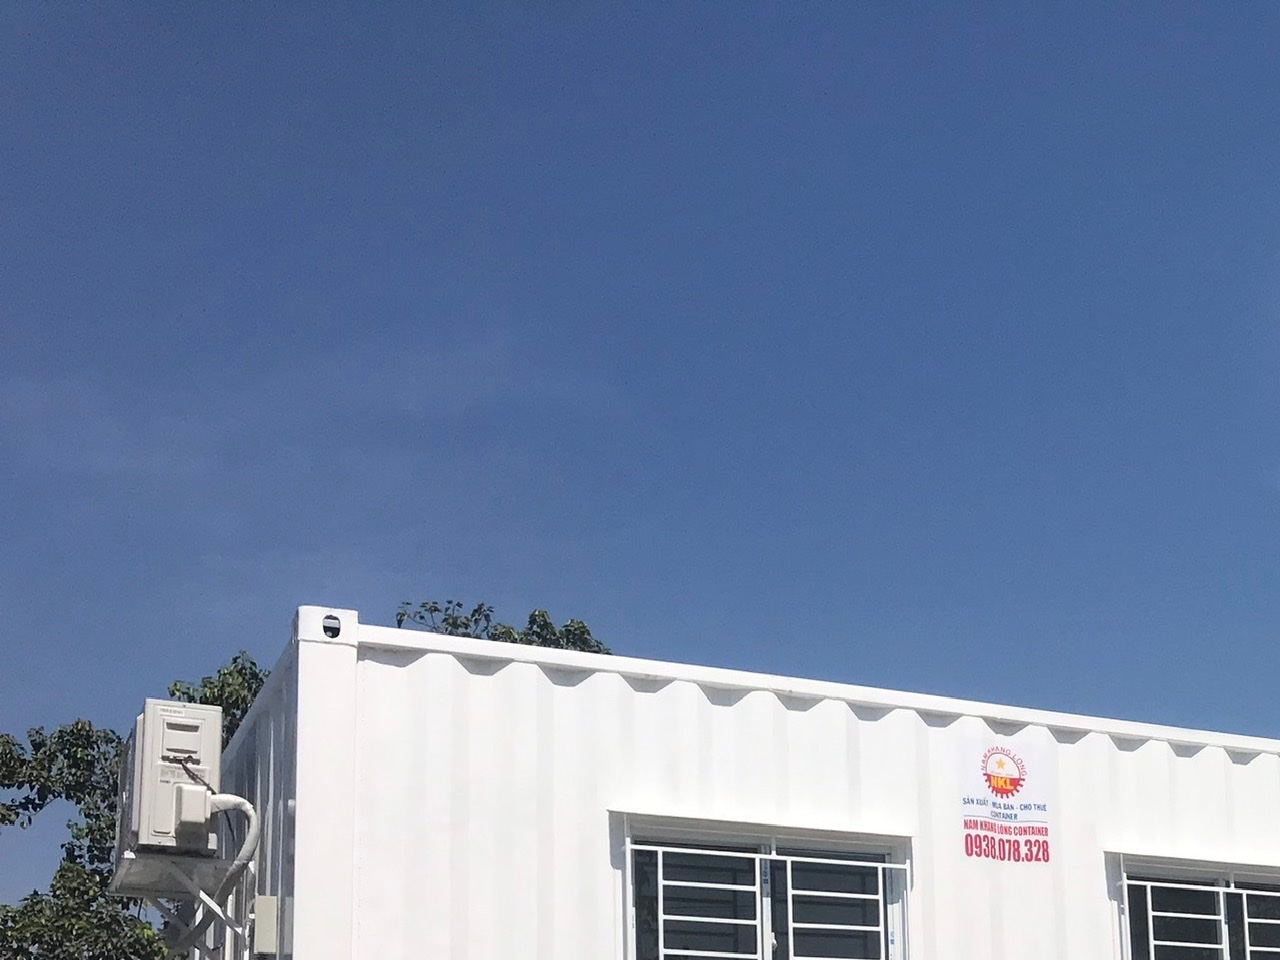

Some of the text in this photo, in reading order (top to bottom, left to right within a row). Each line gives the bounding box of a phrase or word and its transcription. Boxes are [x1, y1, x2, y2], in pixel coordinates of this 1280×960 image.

[991, 775, 1015, 790] NKL
[1019, 803, 1033, 811] CHO
[990, 810, 1018, 820] CONTAINER
[963, 819, 1049, 837] NAM KHANG LONG CONTAINER
[964, 833, 1050, 863] 0938.078.328
